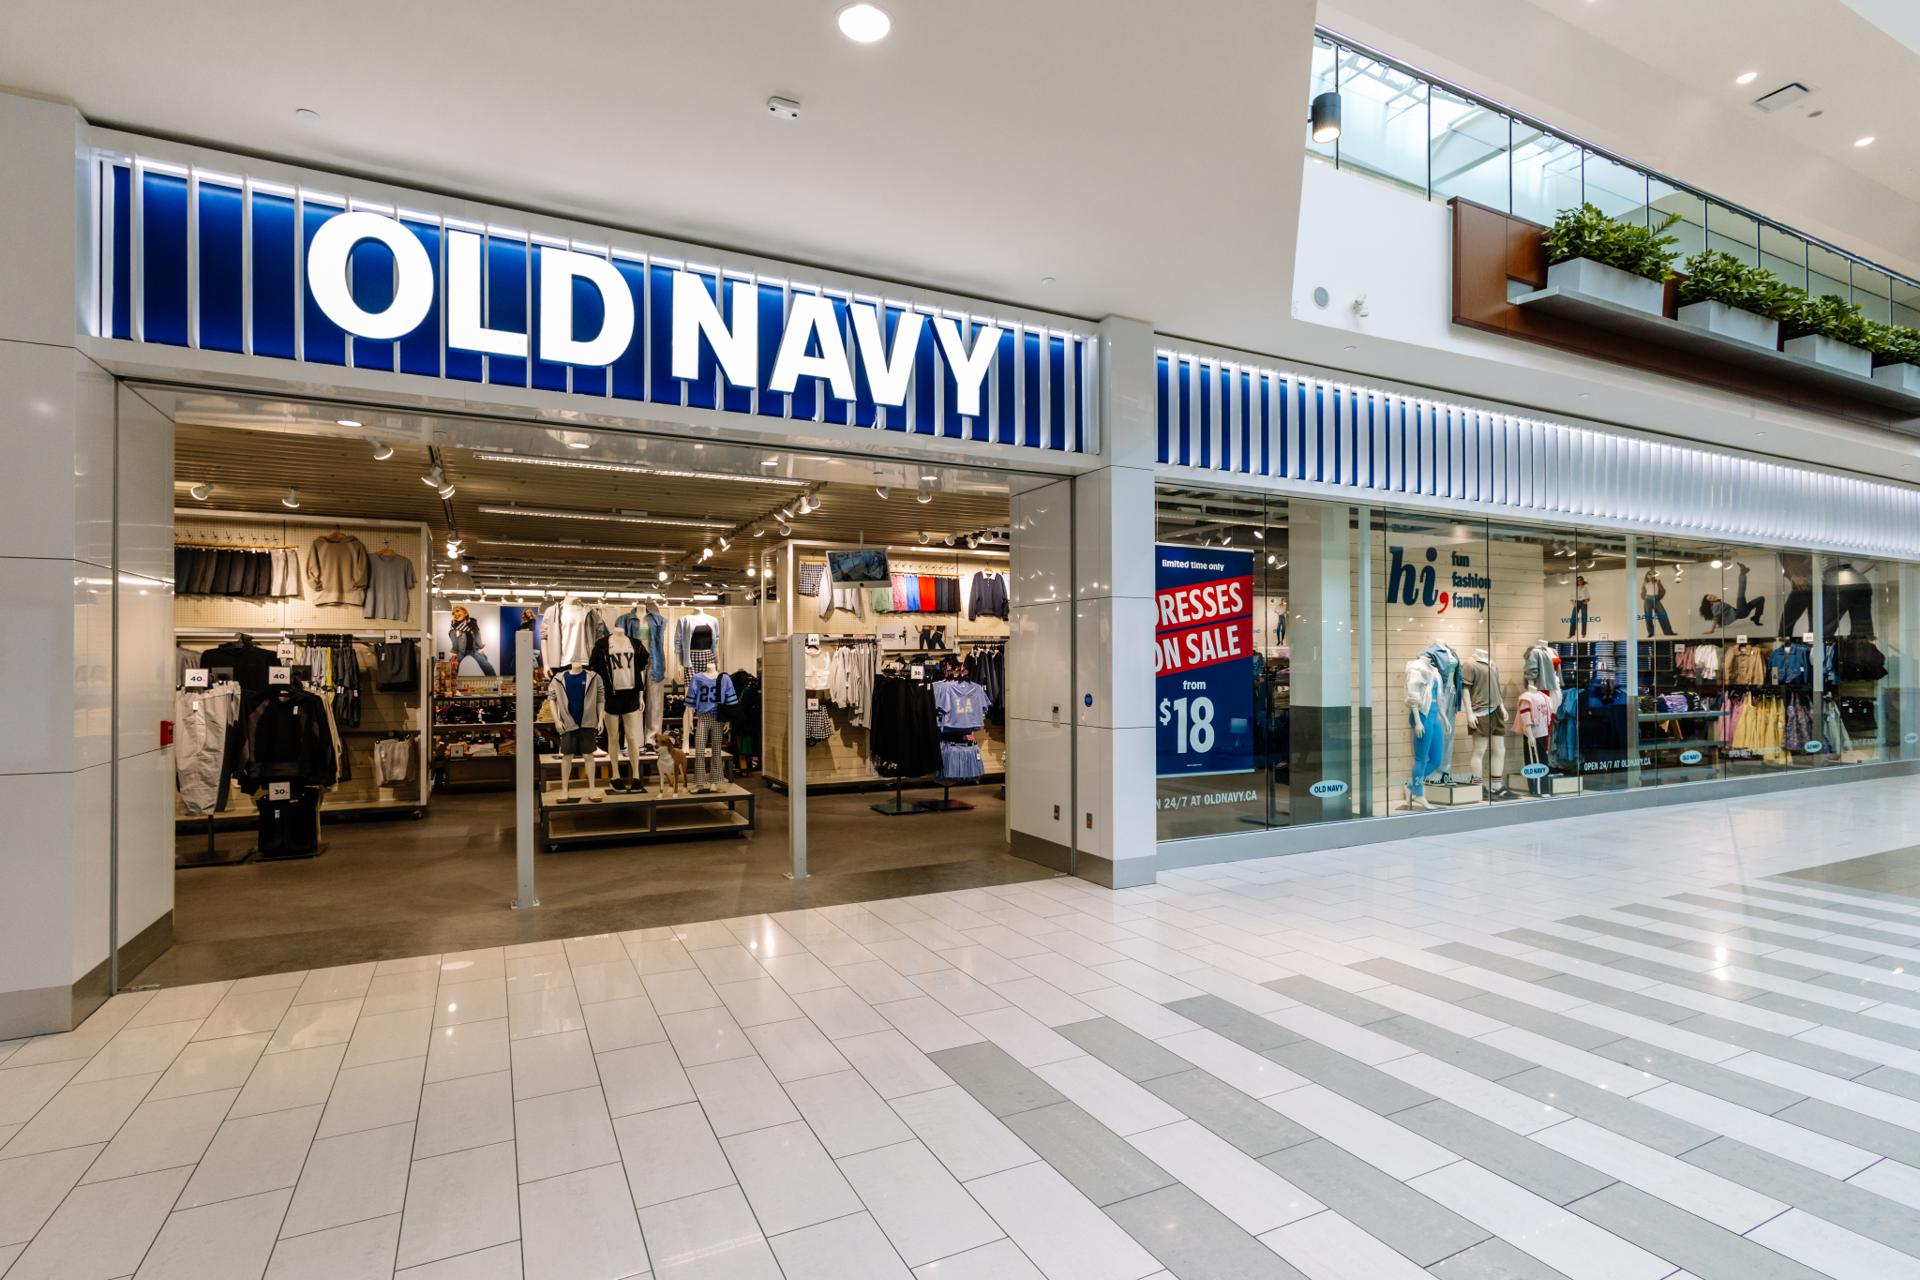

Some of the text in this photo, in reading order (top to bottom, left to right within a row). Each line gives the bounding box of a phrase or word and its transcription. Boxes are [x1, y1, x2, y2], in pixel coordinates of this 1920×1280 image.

[307, 211, 1003, 417] OLD NAVY
[1162, 560, 1225, 572] limited time only
[1451, 551, 1470, 567] fun
[1452, 571, 1492, 589] fashion
[1452, 592, 1486, 613] family
[1186, 625, 1241, 665] SALE
[609, 652, 634, 670] NY
[1183, 680, 1206, 690] from
[956, 698, 973, 713] LA
[1160, 696, 1215, 754] $18
[1314, 784, 1344, 793] OLD NAVY
[1164, 796, 1187, 809] 24/7
[1190, 795, 1202, 807] AT
[1204, 790, 1258, 805] OLDNAVY.CA
